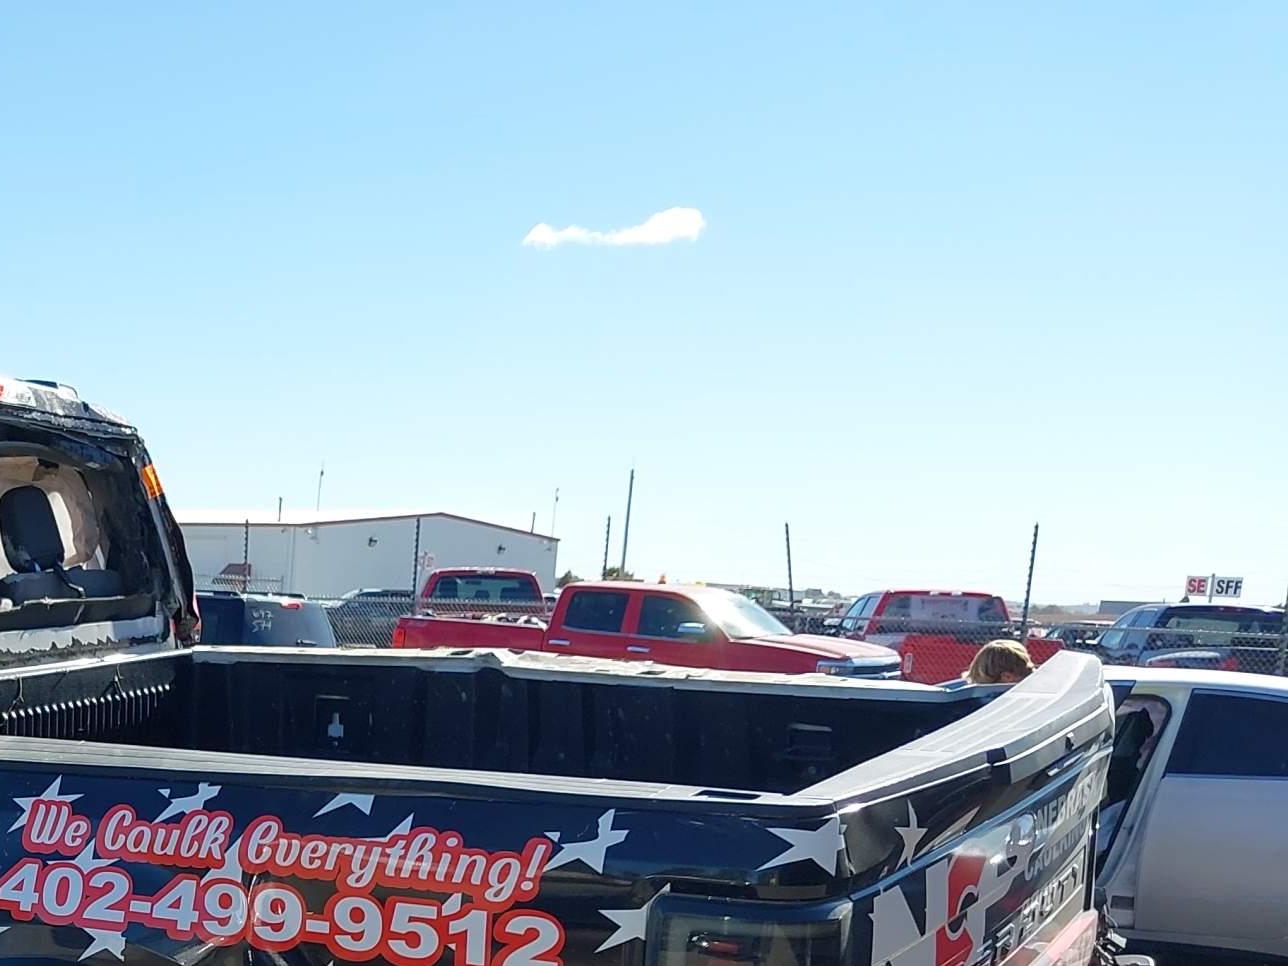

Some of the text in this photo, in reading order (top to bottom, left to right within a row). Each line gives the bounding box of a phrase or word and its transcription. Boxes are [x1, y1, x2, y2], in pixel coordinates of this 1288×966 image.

[1187, 578, 1207, 594] SE
[1215, 579, 1243, 595] SFF
[30, 804, 548, 904] We Caulk Everything!
